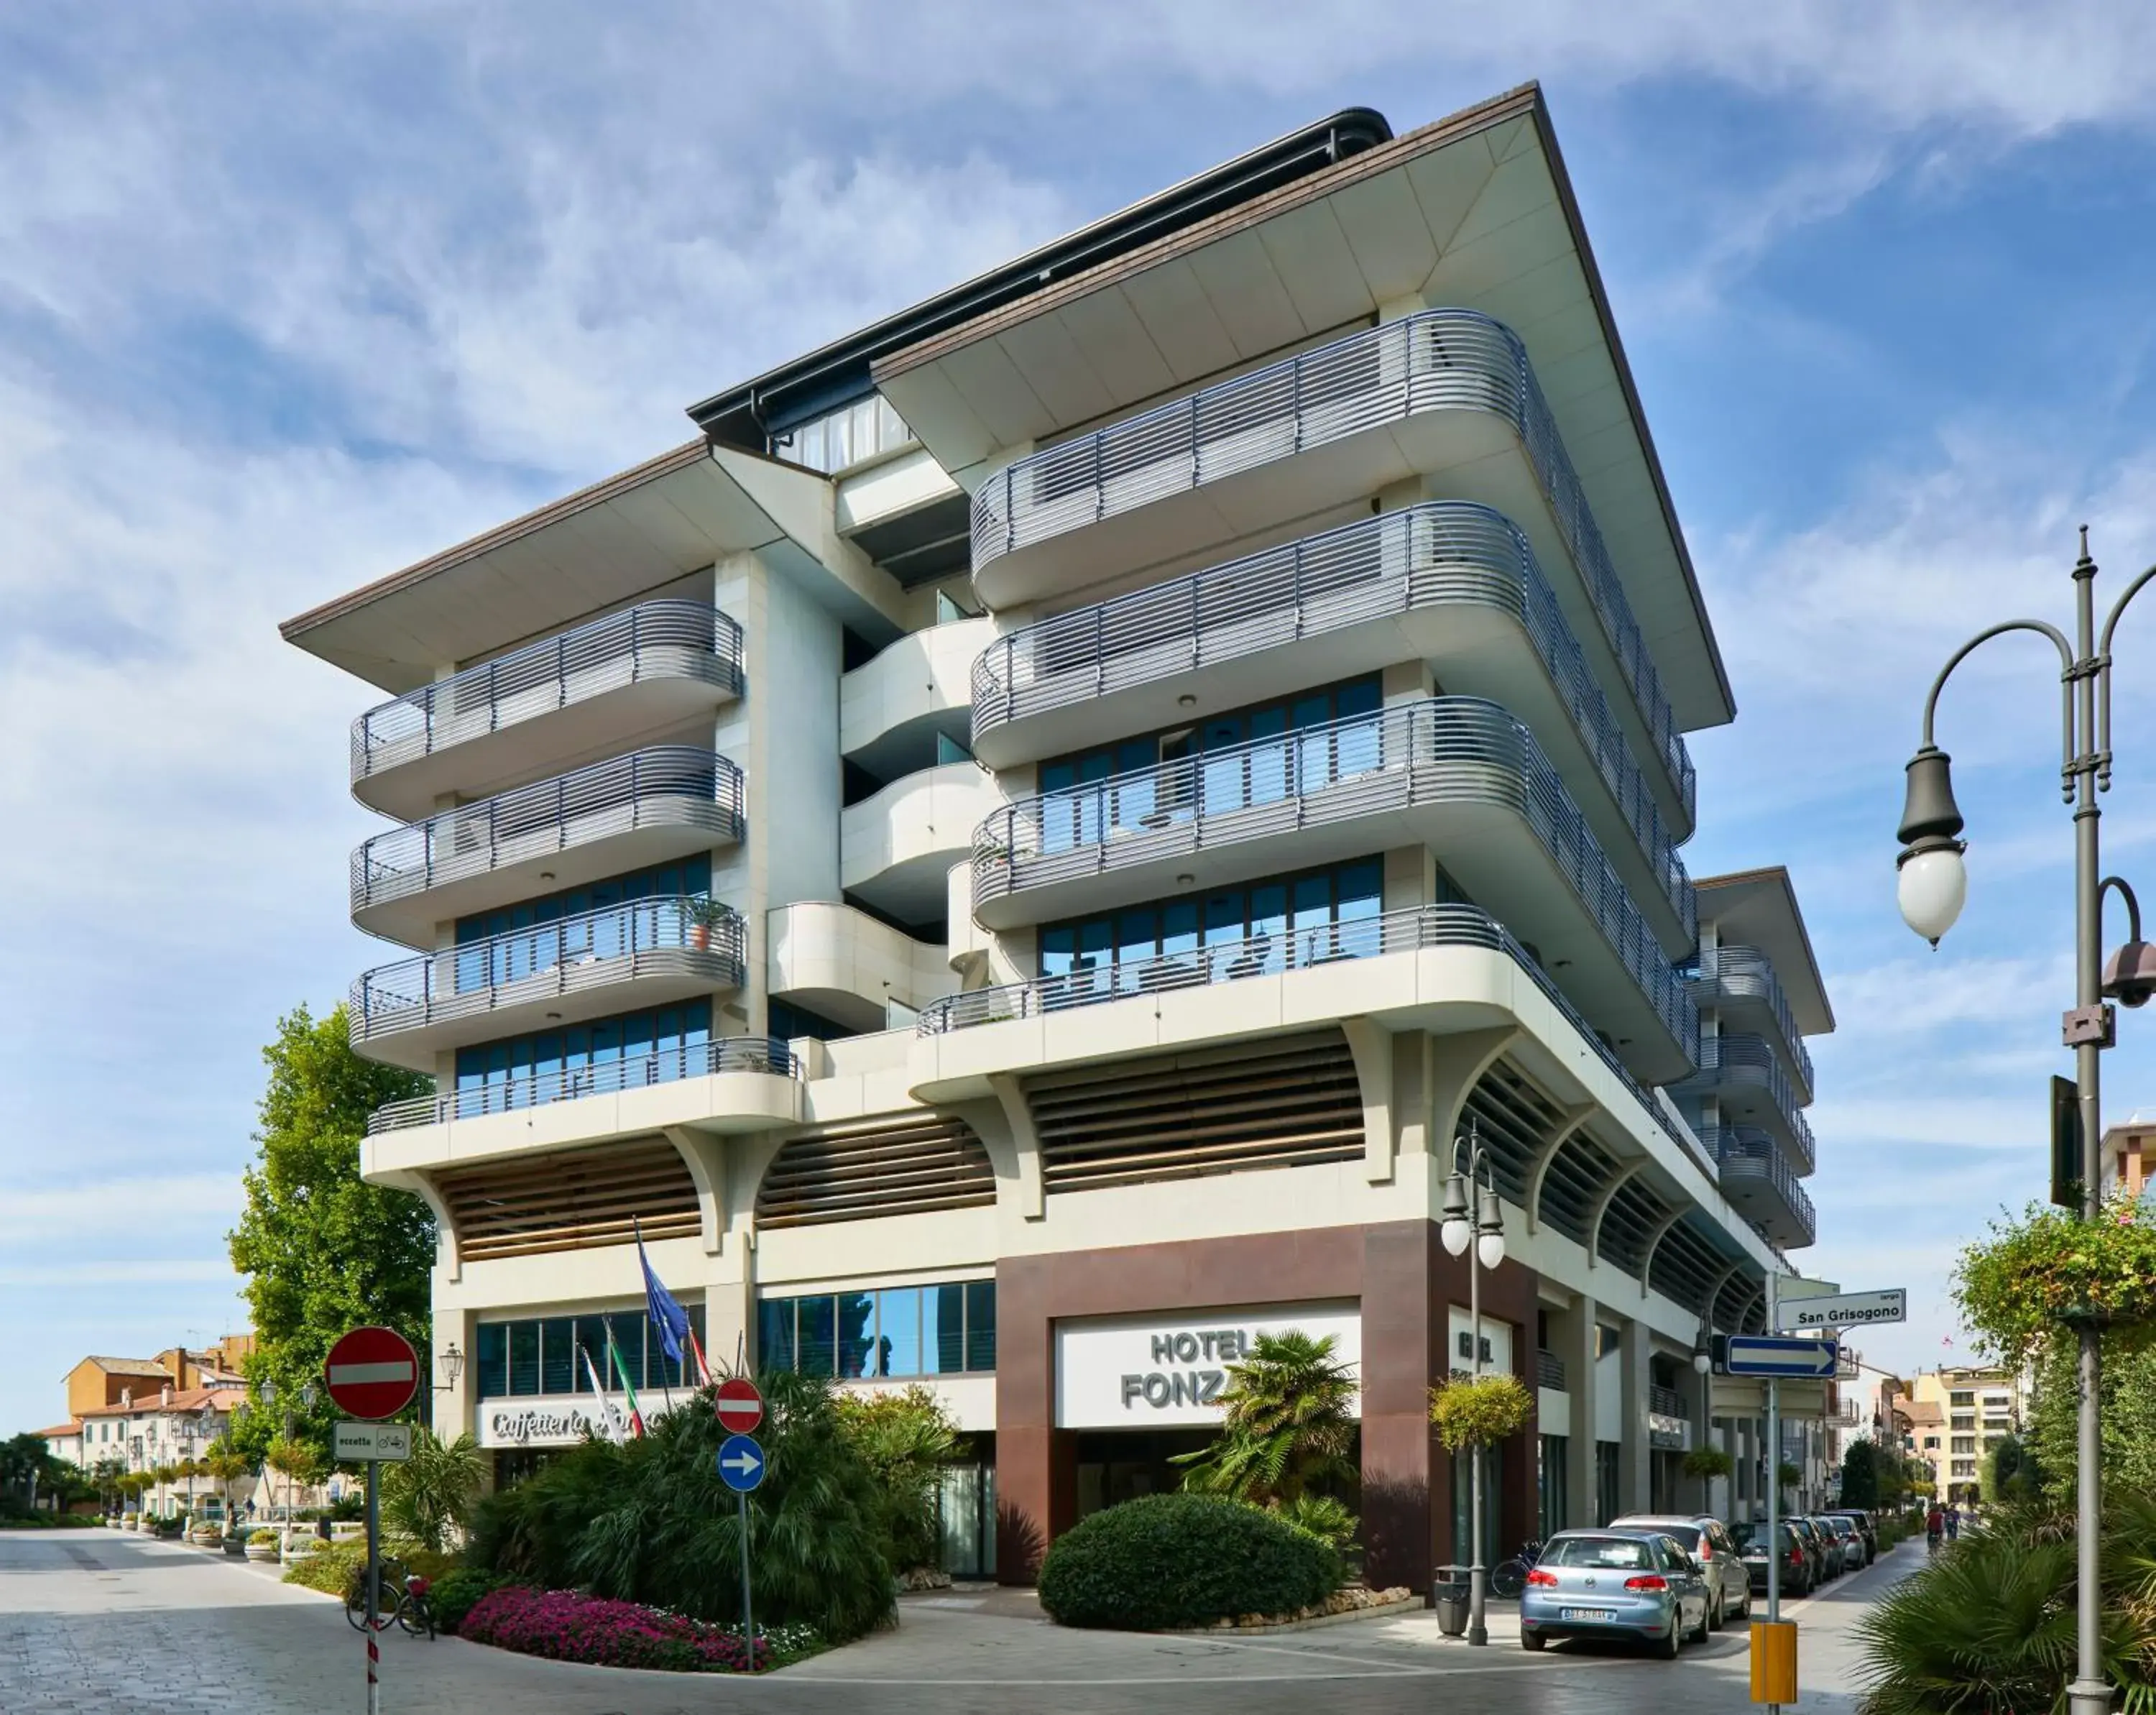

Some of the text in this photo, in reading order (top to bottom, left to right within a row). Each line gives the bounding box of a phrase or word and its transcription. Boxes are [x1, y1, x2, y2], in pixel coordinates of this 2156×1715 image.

[1799, 1307, 1899, 1323] San Grisogono
[1151, 1330, 1256, 1364] HOTEL
[1120, 1370, 1226, 1409] FONZ
